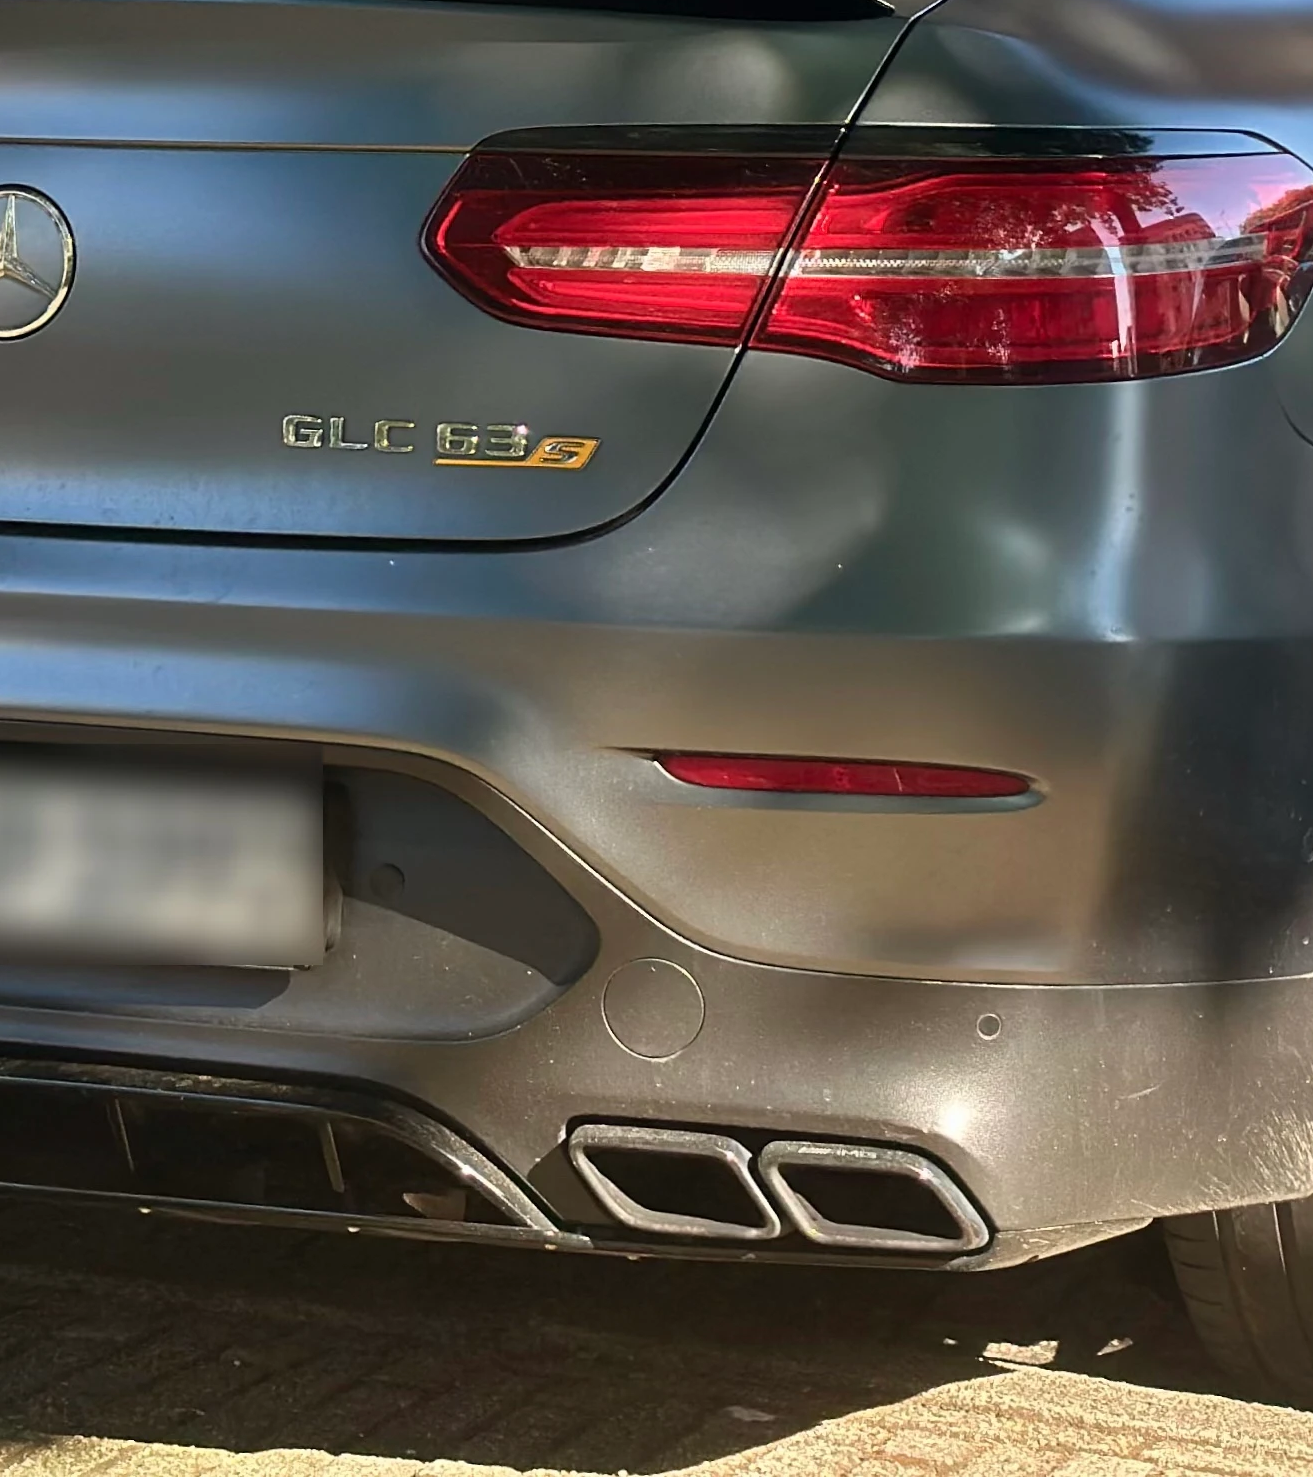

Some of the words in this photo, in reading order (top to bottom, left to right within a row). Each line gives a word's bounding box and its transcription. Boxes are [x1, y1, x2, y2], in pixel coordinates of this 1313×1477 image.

[282, 414, 415, 453] GLC
[436, 422, 529, 457] 63
[540, 440, 581, 466] S
